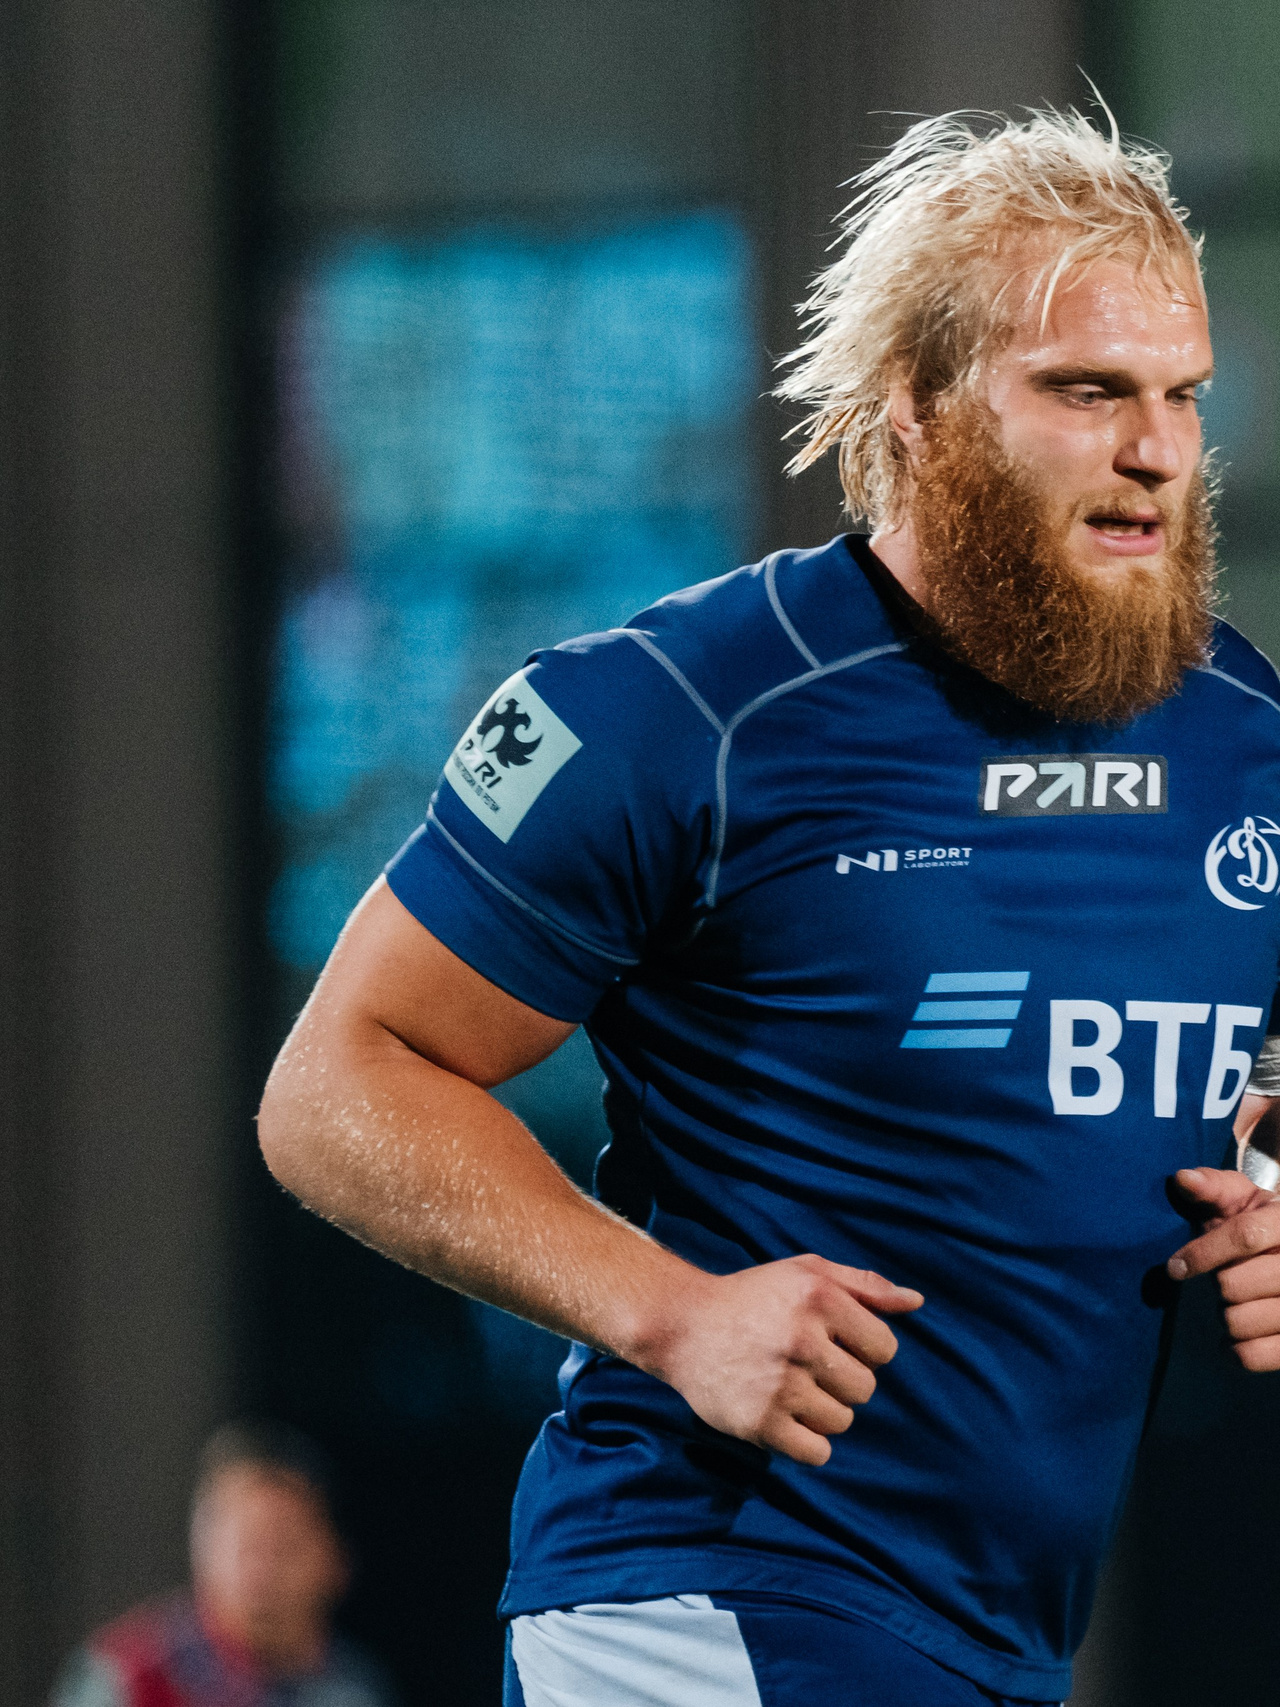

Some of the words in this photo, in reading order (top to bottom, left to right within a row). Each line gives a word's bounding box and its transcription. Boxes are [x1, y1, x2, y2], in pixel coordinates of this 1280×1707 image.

[983, 761, 1162, 811] PARI
[903, 860, 970, 869] LABORATORY
[904, 847, 973, 861] SPORT
[1047, 999, 1264, 1120] ВТБ
